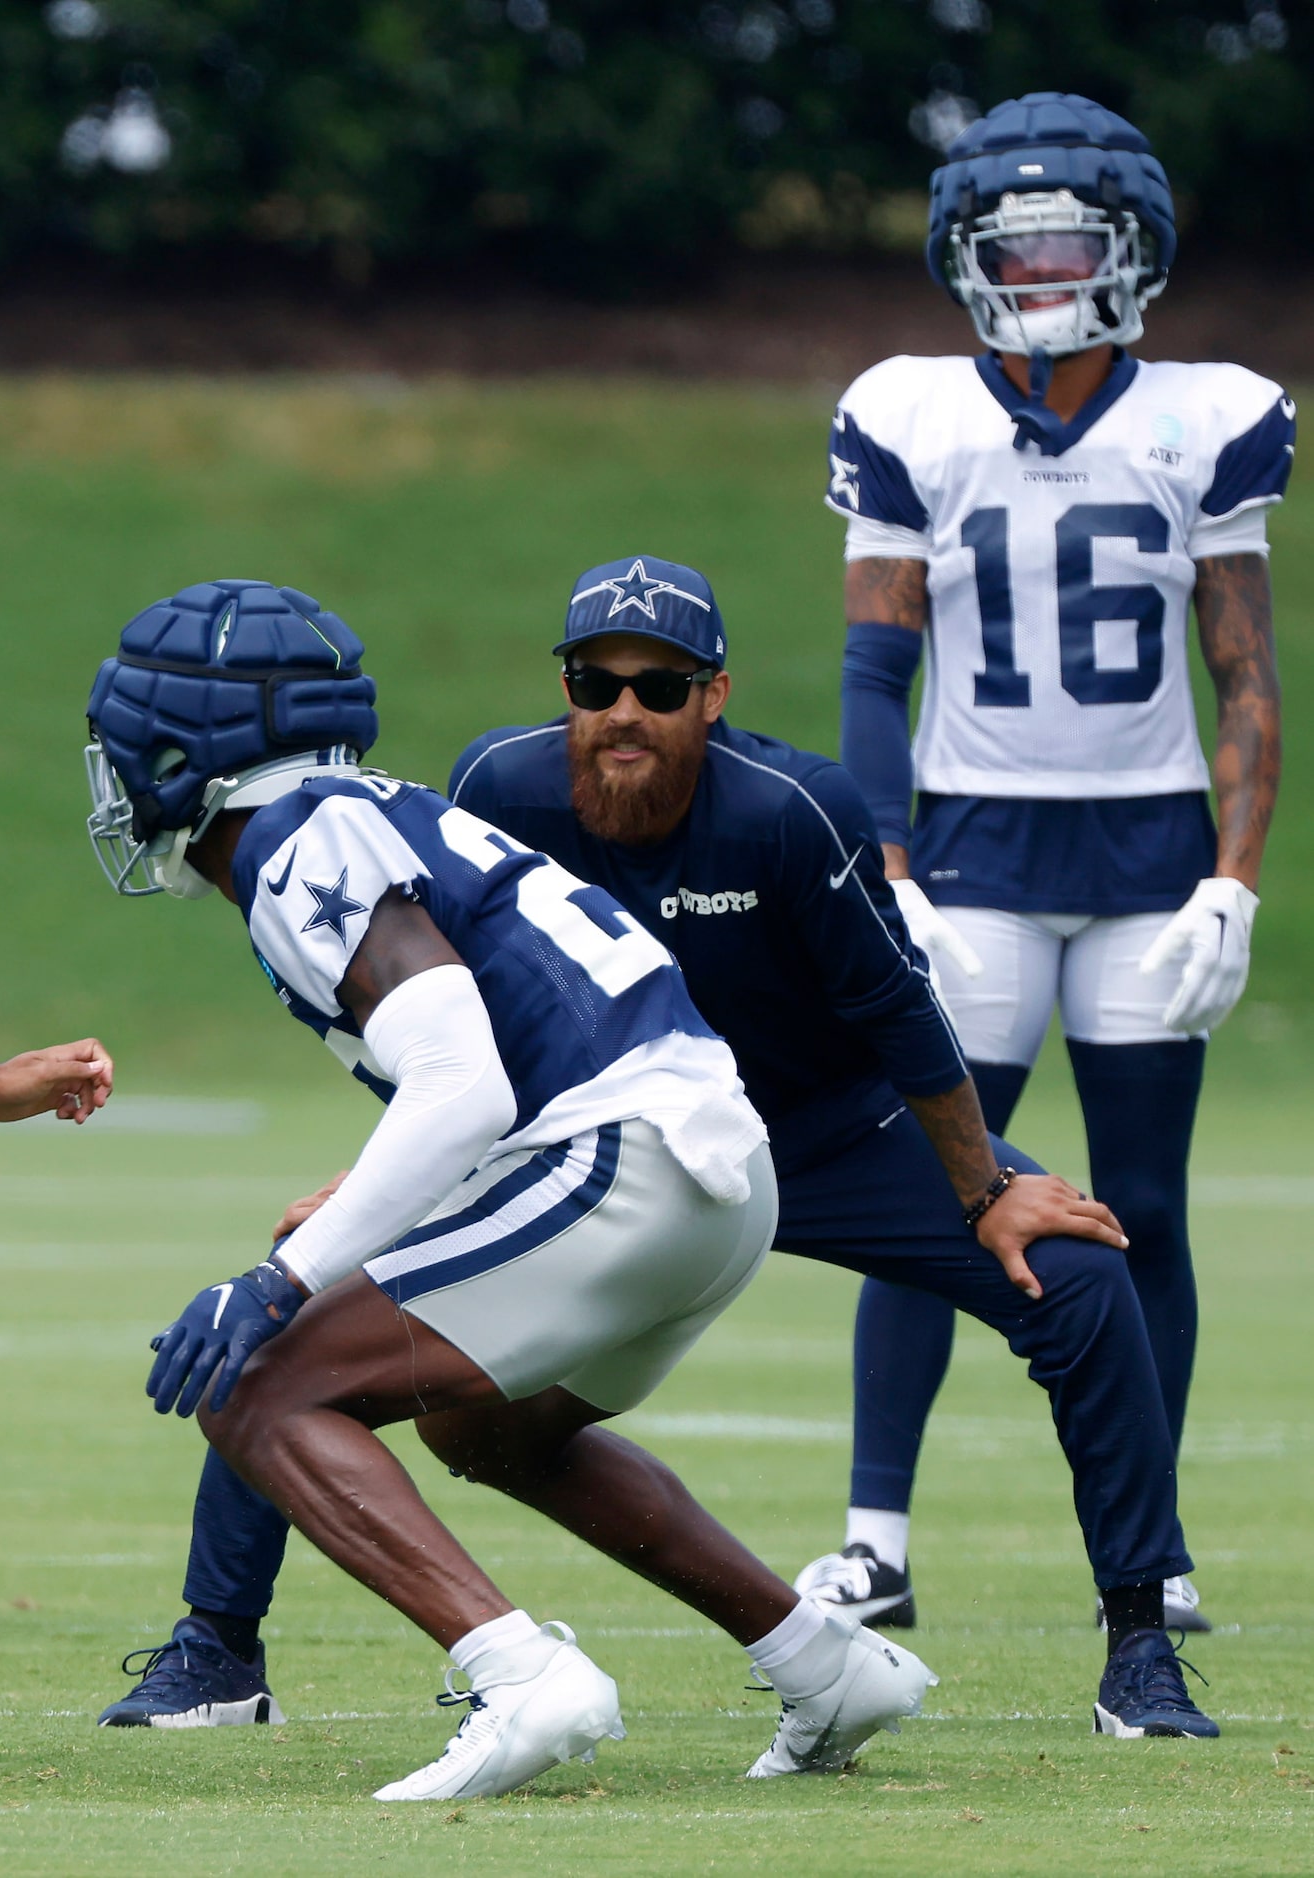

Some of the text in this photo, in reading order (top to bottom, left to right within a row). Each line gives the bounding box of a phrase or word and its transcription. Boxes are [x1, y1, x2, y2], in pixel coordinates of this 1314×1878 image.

[1147, 447, 1184, 466] AT&T
[960, 502, 1170, 708] 16
[660, 887, 759, 919] CWBOYS
